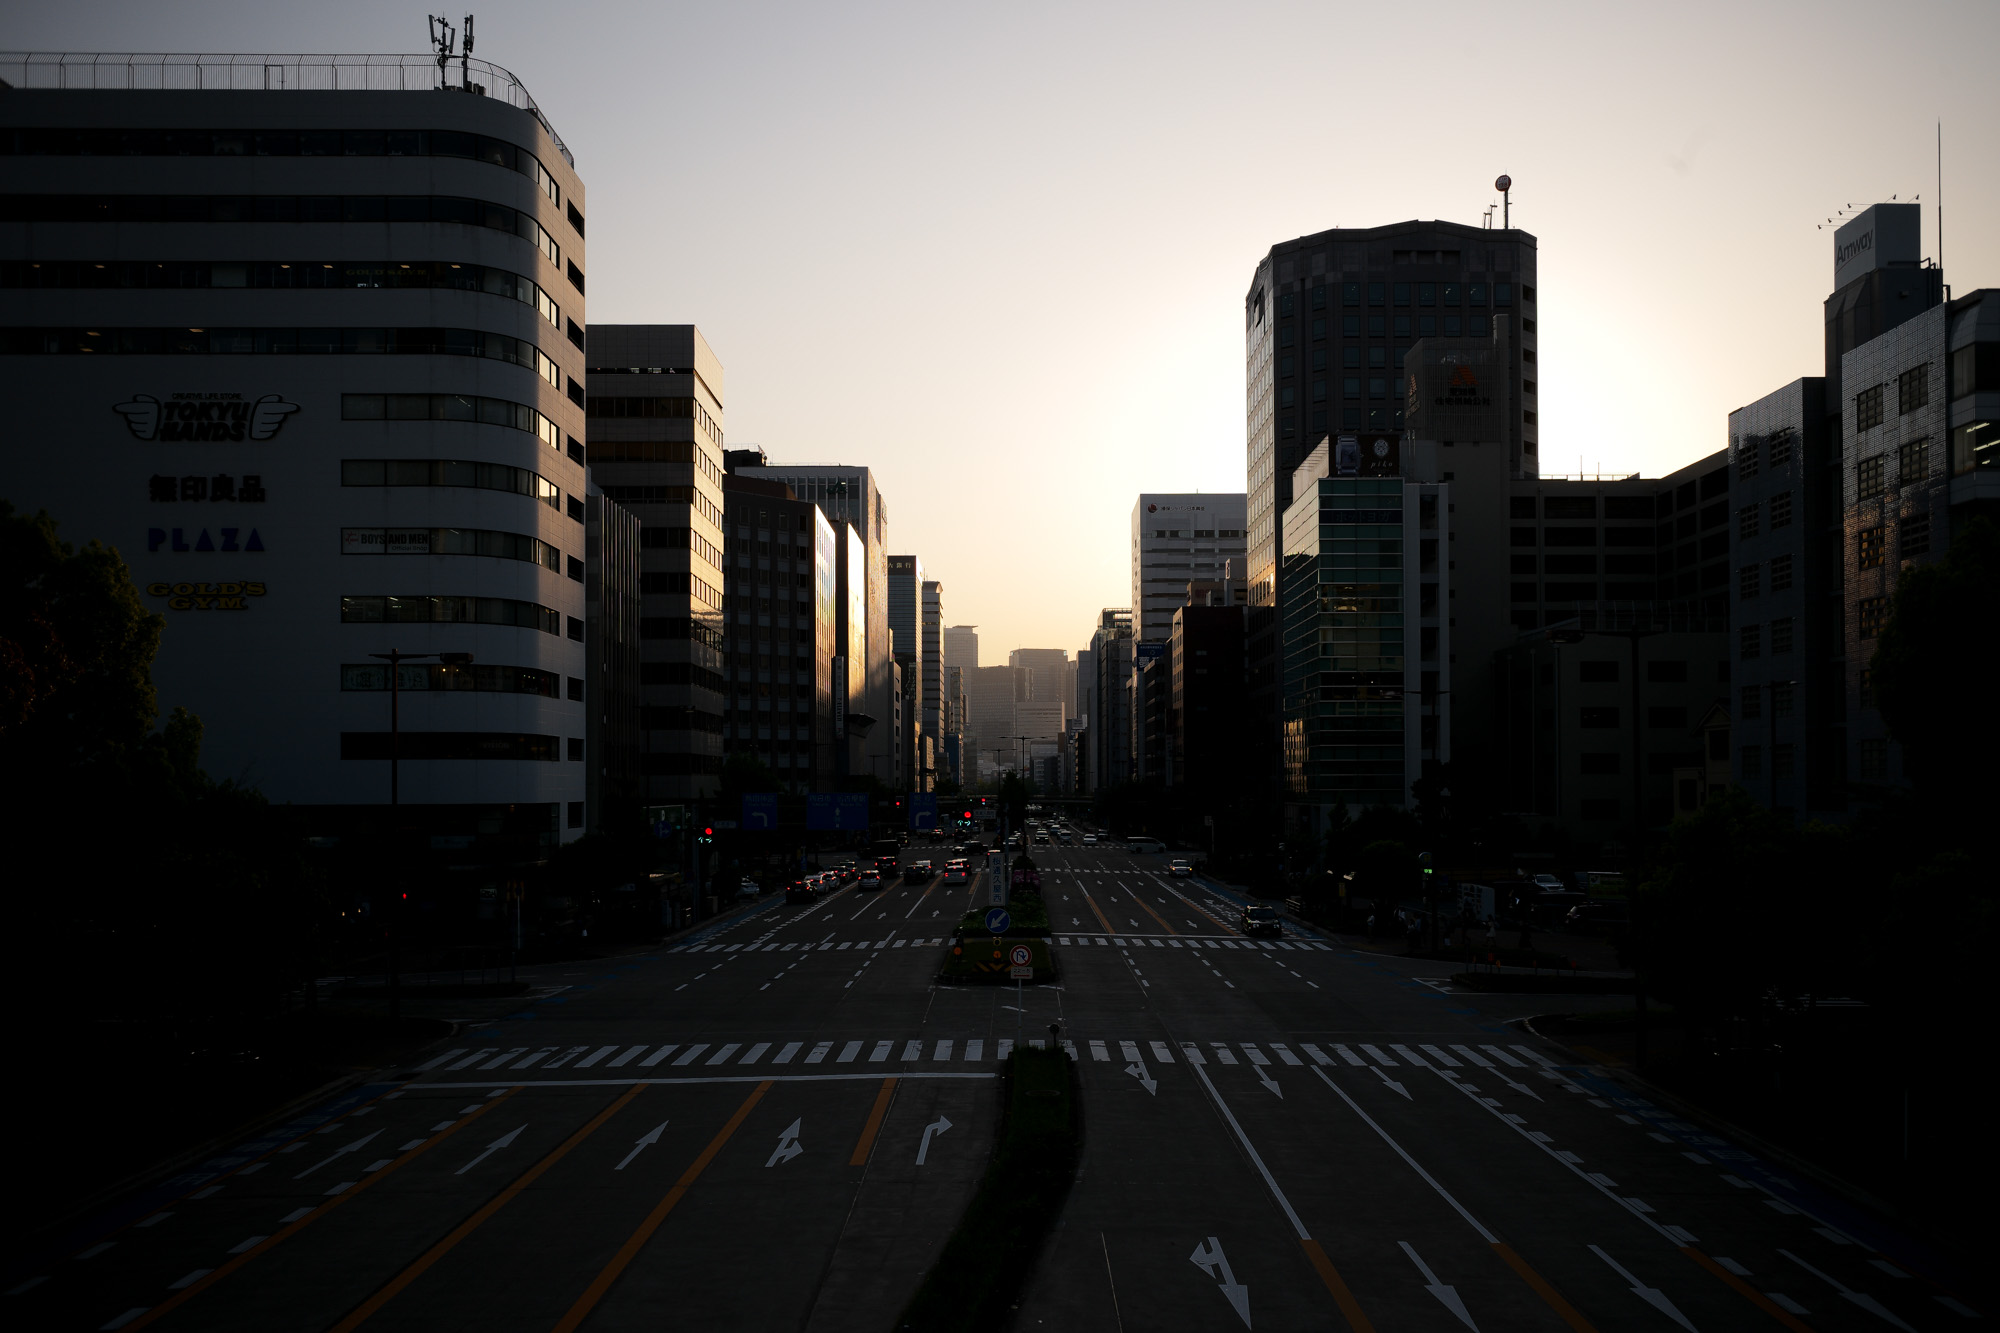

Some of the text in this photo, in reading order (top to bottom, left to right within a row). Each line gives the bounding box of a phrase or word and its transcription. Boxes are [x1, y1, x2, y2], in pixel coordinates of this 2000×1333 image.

[1836, 229, 1873, 265] Amway
[164, 401, 251, 421] TOKYU
[160, 422, 246, 441] HANDS
[149, 474, 266, 502] 無印良品
[148, 527, 265, 552] PLAZA
[361, 534, 385, 545] BOYS
[388, 533, 407, 545] AND
[408, 533, 428, 545] MEN
[146, 581, 267, 597] GOLD'S
[168, 596, 249, 610] GYM
